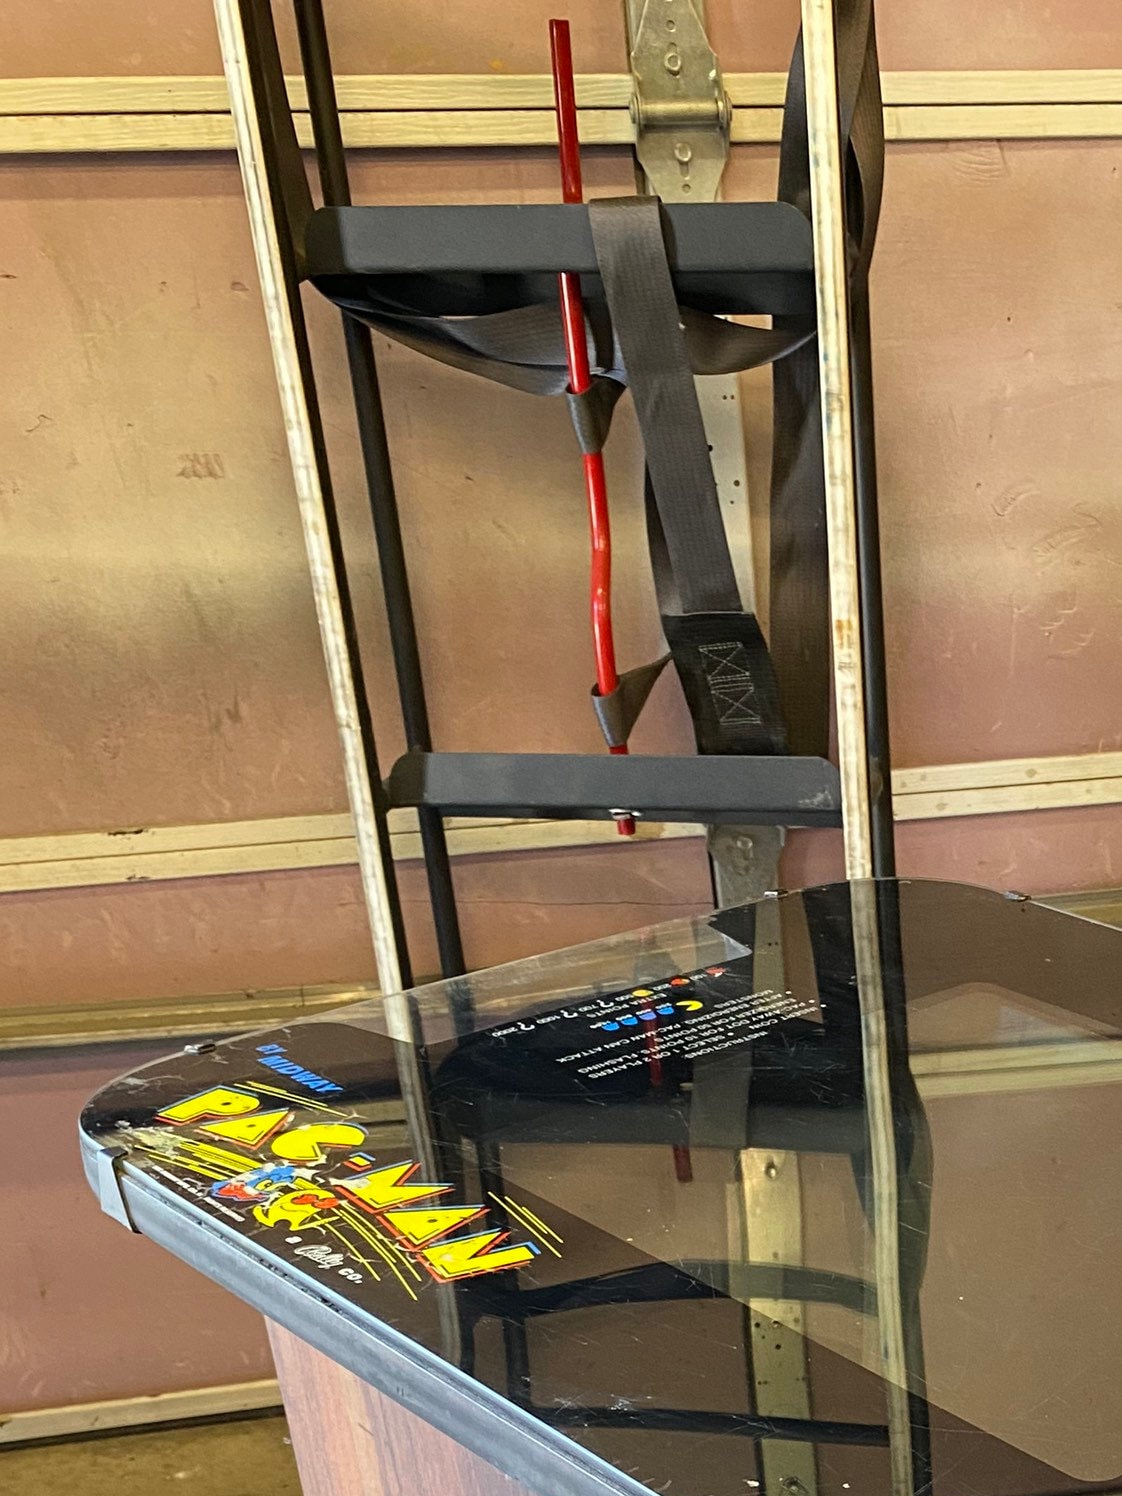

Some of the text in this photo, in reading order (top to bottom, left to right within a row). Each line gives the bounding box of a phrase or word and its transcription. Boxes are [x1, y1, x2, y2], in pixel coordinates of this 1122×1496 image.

[630, 993, 667, 1006] EXTRA
[713, 989, 774, 1009] MONSTERS
[586, 1004, 629, 1018] POINTS
[736, 998, 797, 1020] ENERGIZER
[751, 1002, 806, 1022] PAC-AWAY
[711, 1016, 735, 1027] FOR
[725, 1019, 750, 1029] DOT
[748, 1018, 779, 1031] COIN
[630, 1023, 680, 1042] PAC-MAN
[653, 1027, 696, 1043] POINTS
[685, 1034, 699, 1043] 10
[699, 1026, 725, 1038] FOR
[256, 1043, 287, 1056] BY
[603, 1038, 630, 1049] CAN
[683, 1034, 725, 1050] SELECT
[555, 1046, 602, 1063] ATTACK
[651, 1051, 671, 1061] OR
[577, 1052, 636, 1074] FLASHING
[587, 1060, 643, 1079] PLAYERS
[257, 1054, 346, 1094] MIDWAY
[155, 1085, 542, 1283] PAC-MAN
